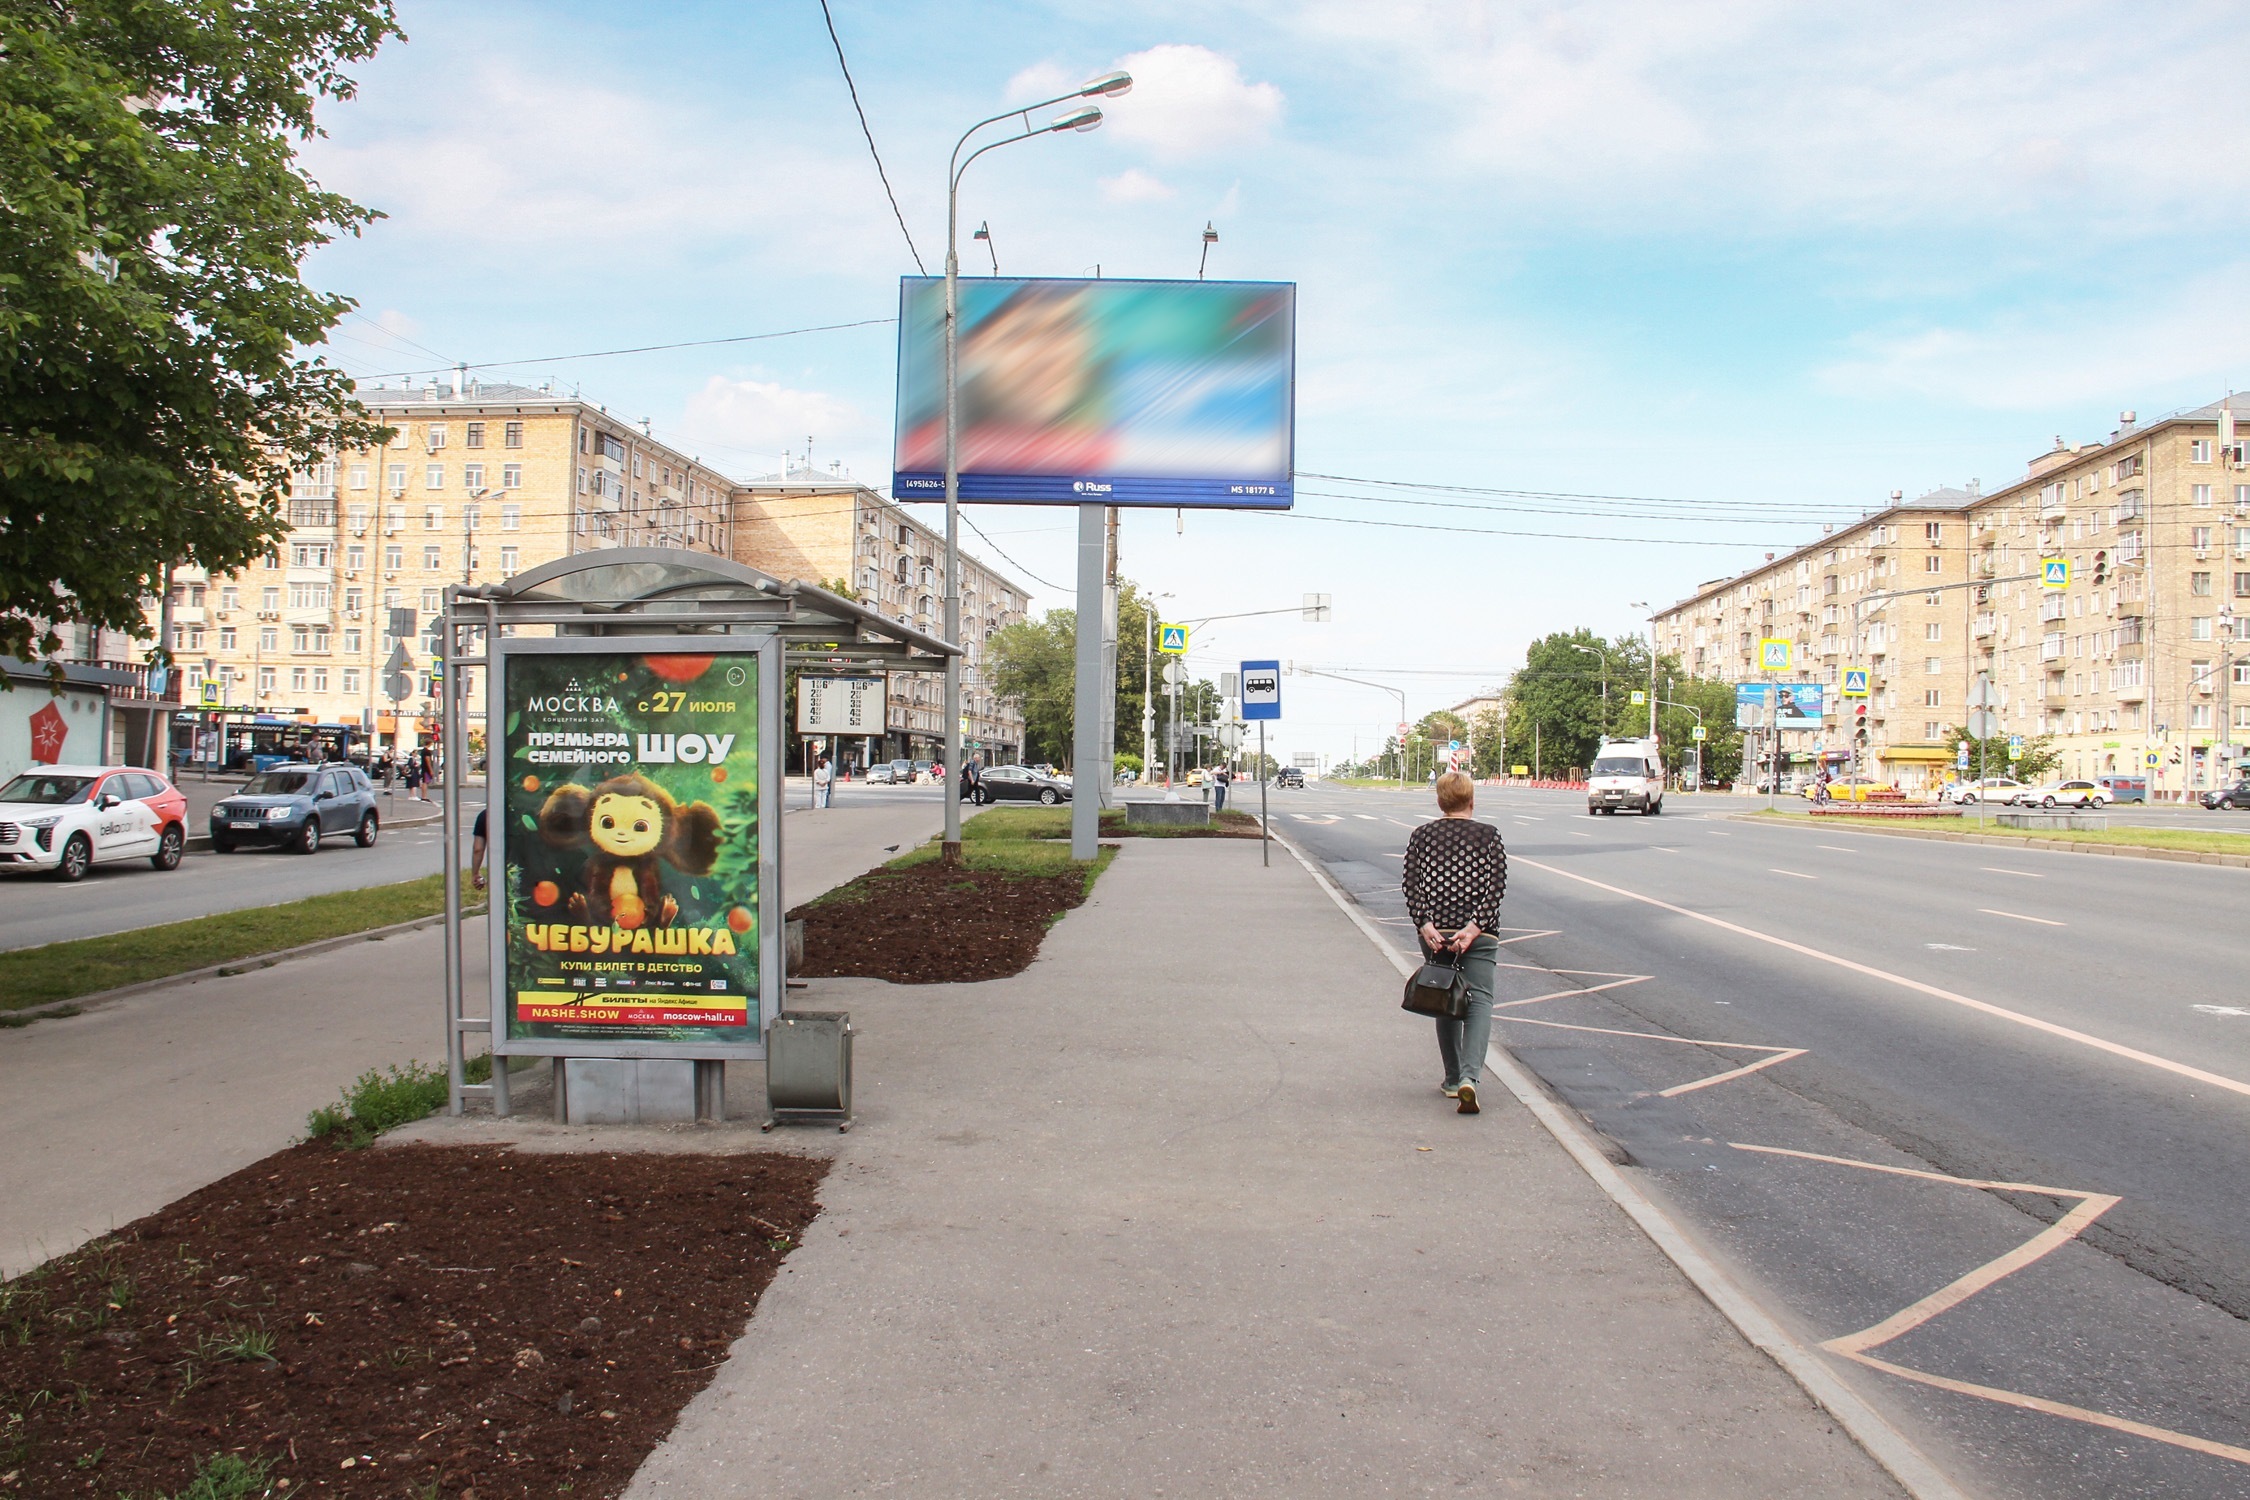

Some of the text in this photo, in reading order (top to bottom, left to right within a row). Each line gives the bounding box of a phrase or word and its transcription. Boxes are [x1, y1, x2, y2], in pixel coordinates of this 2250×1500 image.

[1086, 482, 1112, 491] Russ
[1231, 485, 1243, 493] MS
[1245, 486, 1267, 494] 18177
[823, 680, 828, 689] 6
[862, 682, 868, 690] 6
[811, 689, 816, 697] 2
[851, 691, 856, 699] 2
[528, 696, 619, 713] МОСКВА
[652, 692, 687, 712] 27
[689, 701, 736, 713] июля
[811, 698, 816, 706] 3
[851, 700, 856, 708] 3
[810, 707, 815, 715] 4
[850, 709, 855, 717] 4
[810, 716, 815, 724] 5
[850, 717, 855, 726] 5
[528, 732, 630, 747] ПРЕМЬЕРА
[637, 733, 736, 765] ШОУ
[527, 748, 631, 764] СЕМЕЙНОГО
[526, 923, 736, 955] ЧЕБУРАШКА
[560, 961, 703, 974] КУПИ БИЛЕТ В ДЕТСТВО
[678, 998, 698, 1006] Афише
[532, 1008, 619, 1019] NASHE.SHOW
[663, 1012, 735, 1021] moscow-hall.ru
